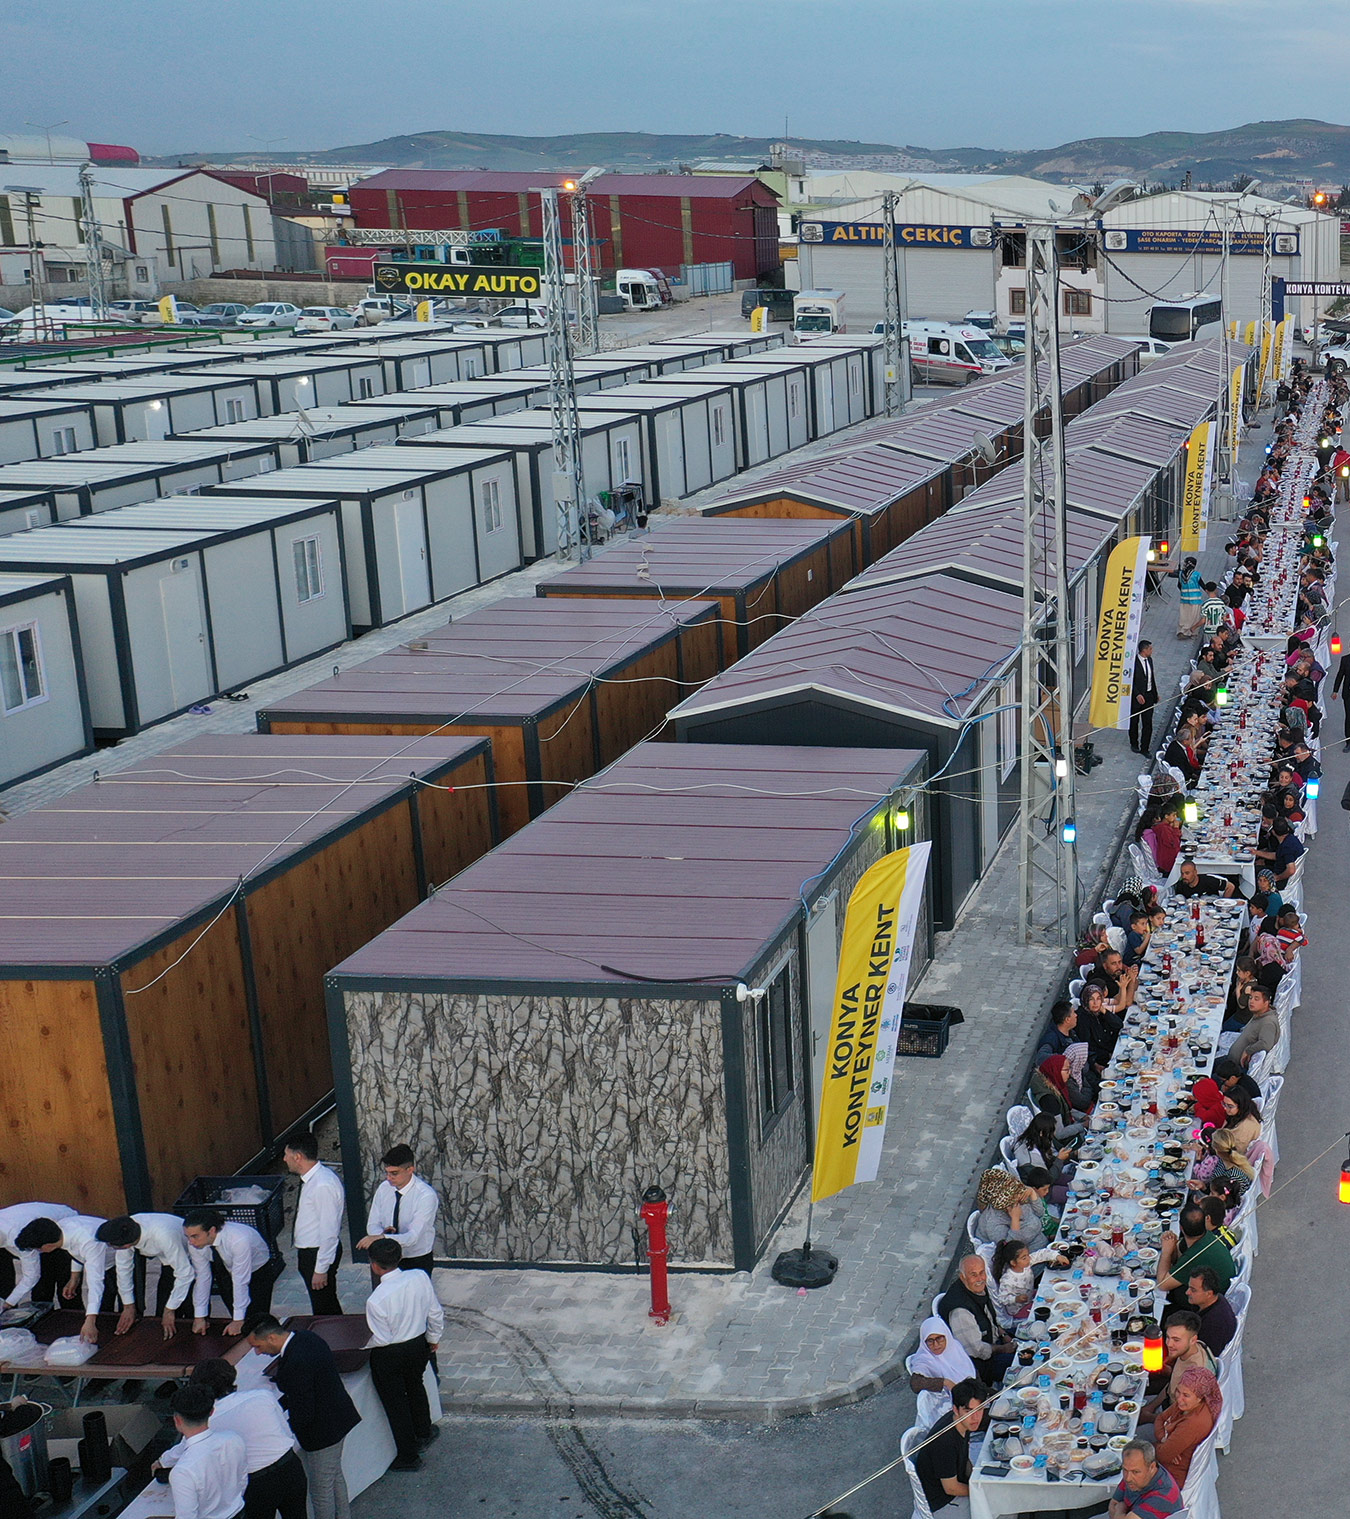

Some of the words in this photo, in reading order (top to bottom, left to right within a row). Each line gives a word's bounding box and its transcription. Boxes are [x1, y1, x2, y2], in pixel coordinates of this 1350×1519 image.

[901, 227, 963, 245] ÇEKİÇ
[405, 272, 470, 290] OKAY
[473, 275, 537, 293] AUTO
[1286, 284, 1313, 294] KONYA
[1185, 471, 1195, 506] KONYA
[1191, 472, 1203, 535] KONTEYNER
[1198, 442, 1206, 472] KENT
[1098, 608, 1115, 661] KONYA
[1106, 610, 1127, 704] KONTEYNER
[1118, 566, 1133, 608] KENT
[830, 982, 861, 1080] KONYA
[842, 983, 884, 1148] KONTEYNER
[868, 903, 896, 978] KENT
